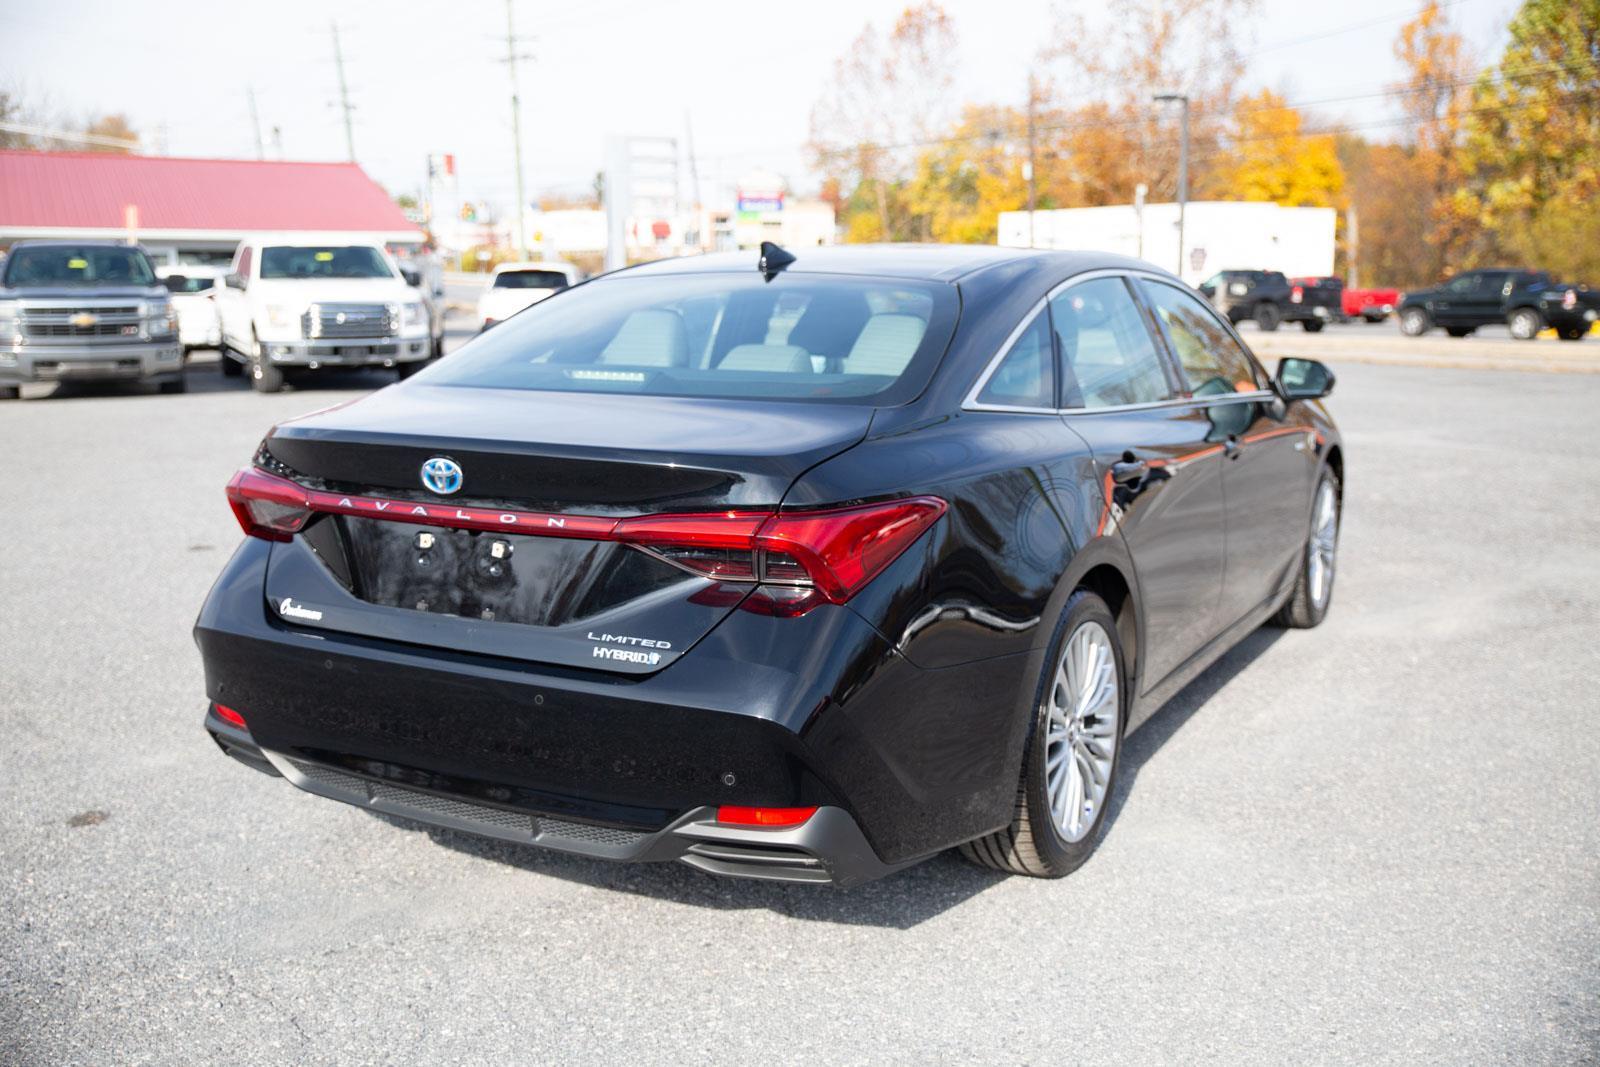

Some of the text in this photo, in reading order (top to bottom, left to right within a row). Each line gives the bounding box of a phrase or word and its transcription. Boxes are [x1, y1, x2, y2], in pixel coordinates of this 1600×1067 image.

[338, 498, 565, 528] AVALON
[587, 632, 672, 649] LIMITED
[592, 647, 649, 664] HYBRID
